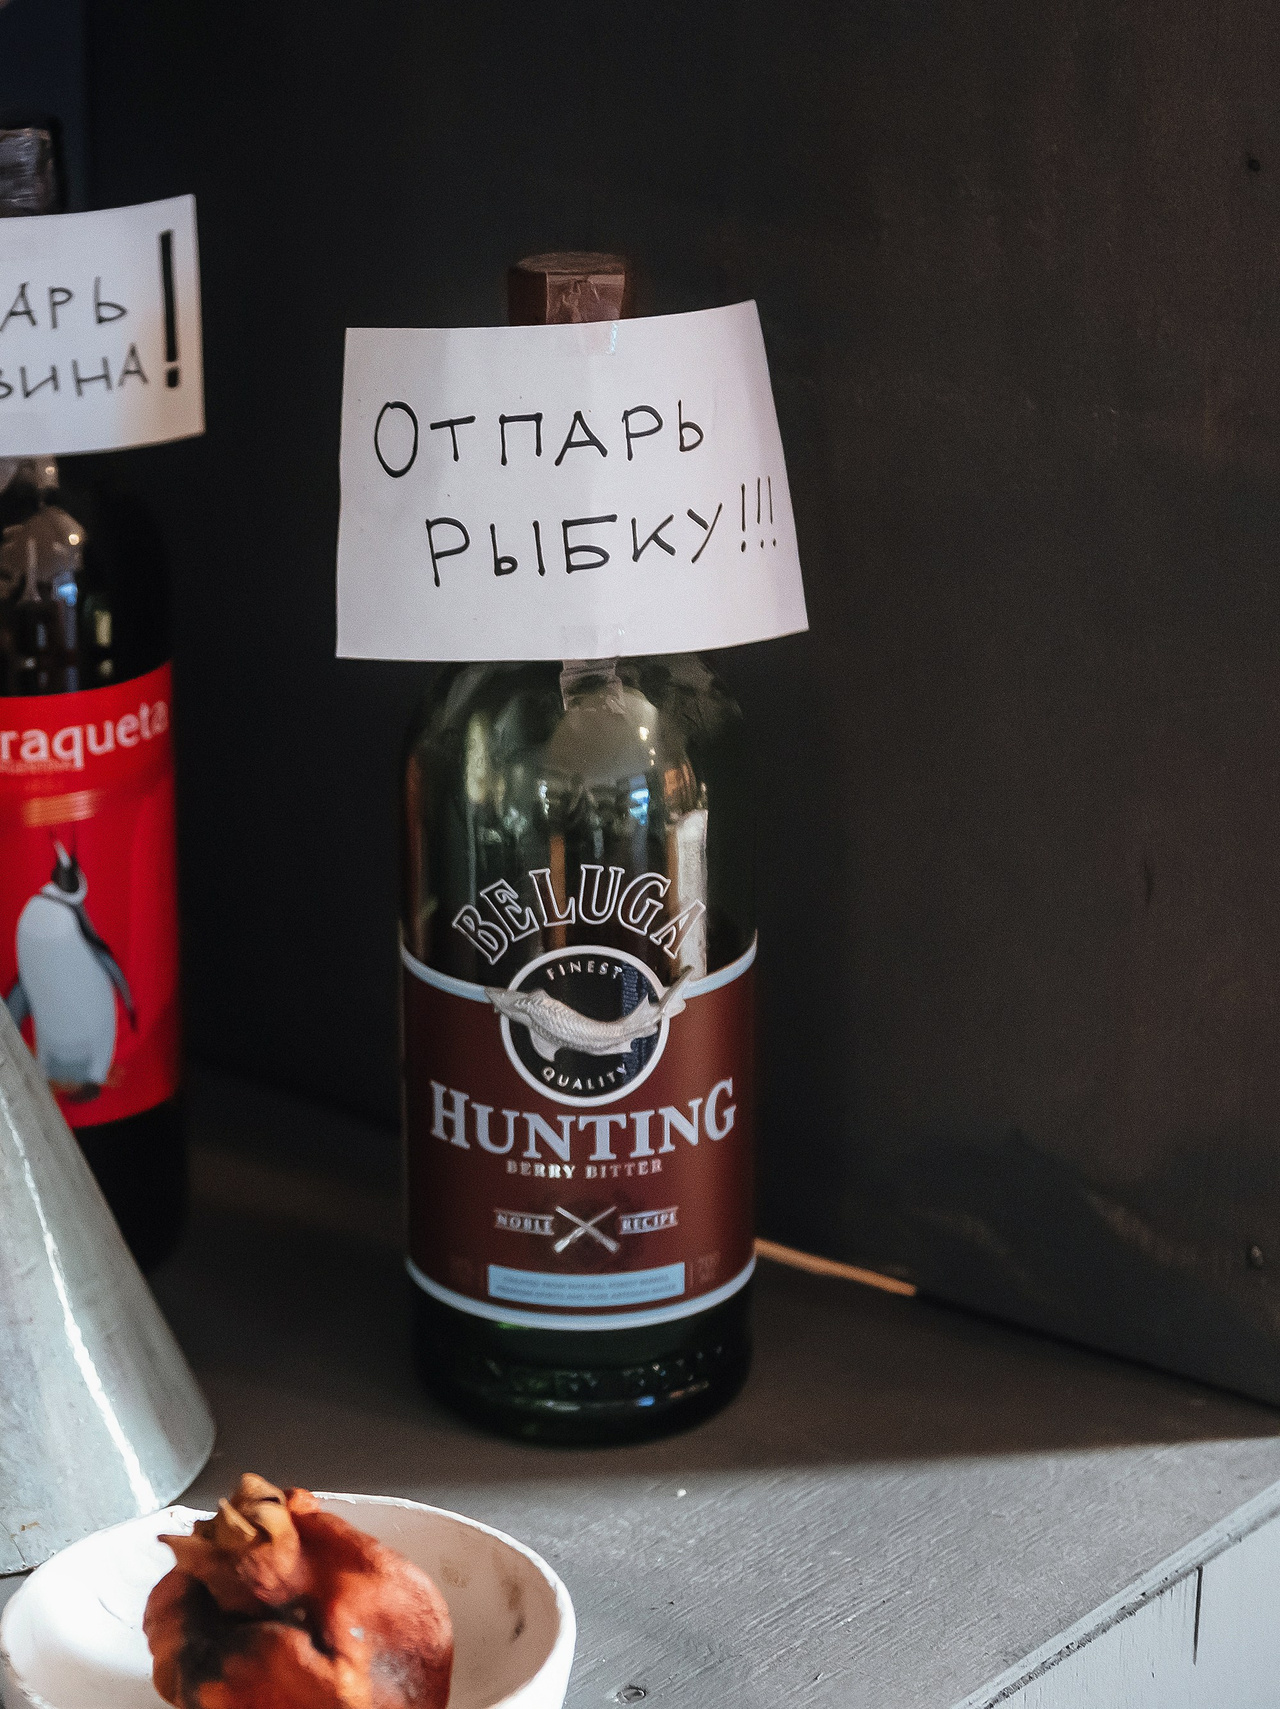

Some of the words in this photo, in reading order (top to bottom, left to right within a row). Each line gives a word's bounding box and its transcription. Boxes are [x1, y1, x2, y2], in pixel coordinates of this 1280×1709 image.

[451, 863, 707, 966] BELUGA
[545, 960, 624, 982] FINEST
[541, 1063, 628, 1091] QUALITY
[429, 1077, 738, 1162] HUNTING
[505, 1159, 576, 1180] BERRY
[584, 1158, 663, 1180] BITTER
